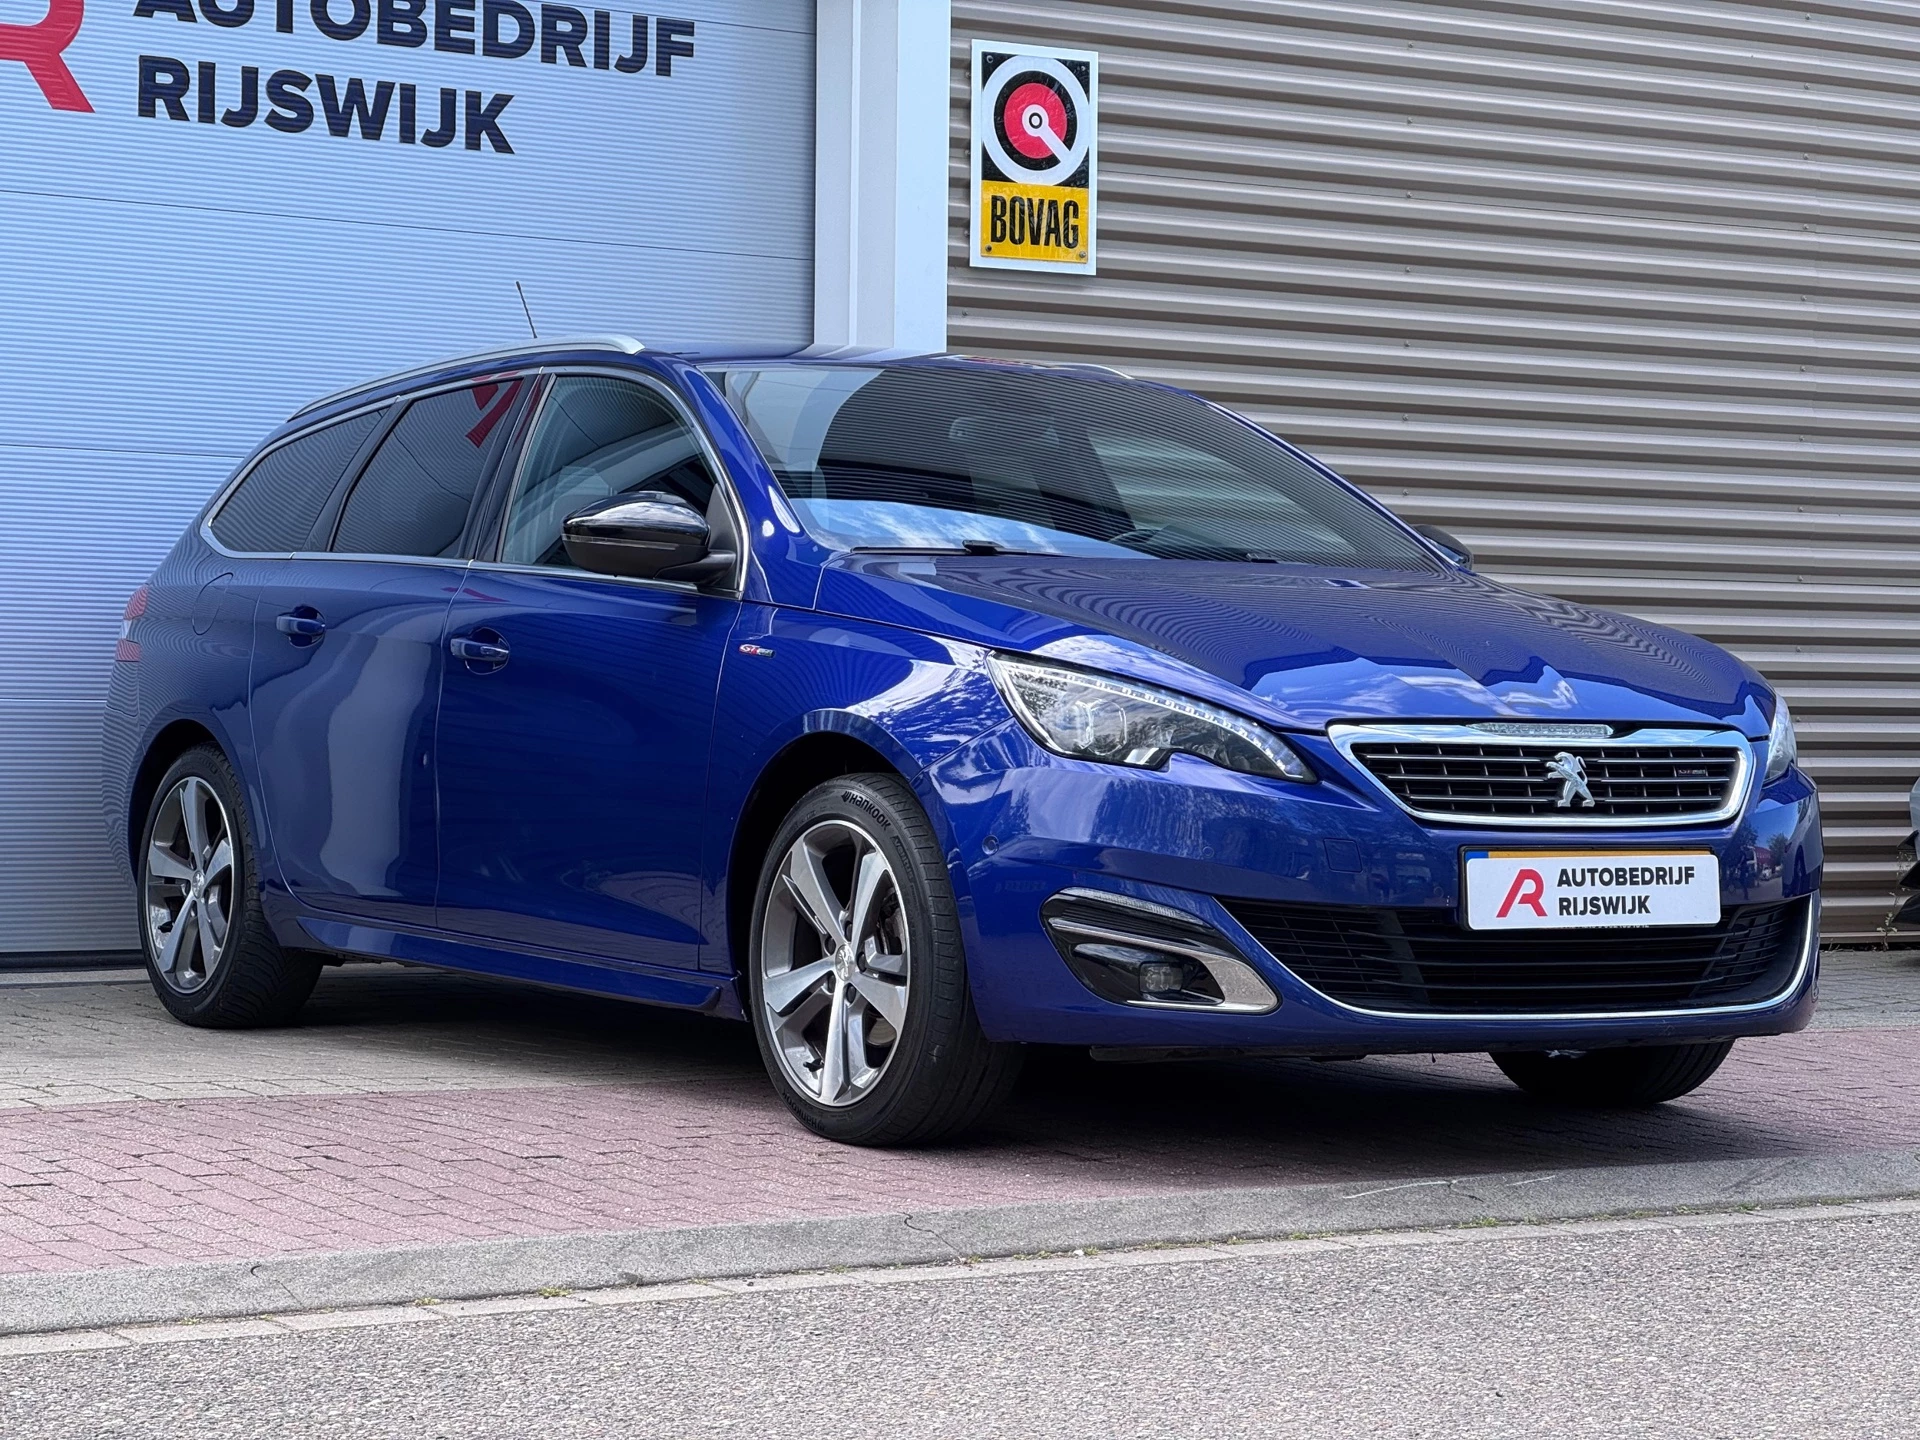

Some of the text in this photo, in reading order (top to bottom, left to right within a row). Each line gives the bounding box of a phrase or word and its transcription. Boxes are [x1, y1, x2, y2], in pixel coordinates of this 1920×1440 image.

[138, 55, 515, 154] RIJSWIJK
[990, 194, 1079, 249] BOVAG
[1556, 866, 1695, 888] AUTOBEDRIJF
[1558, 895, 1651, 916] RIJSWIJK
